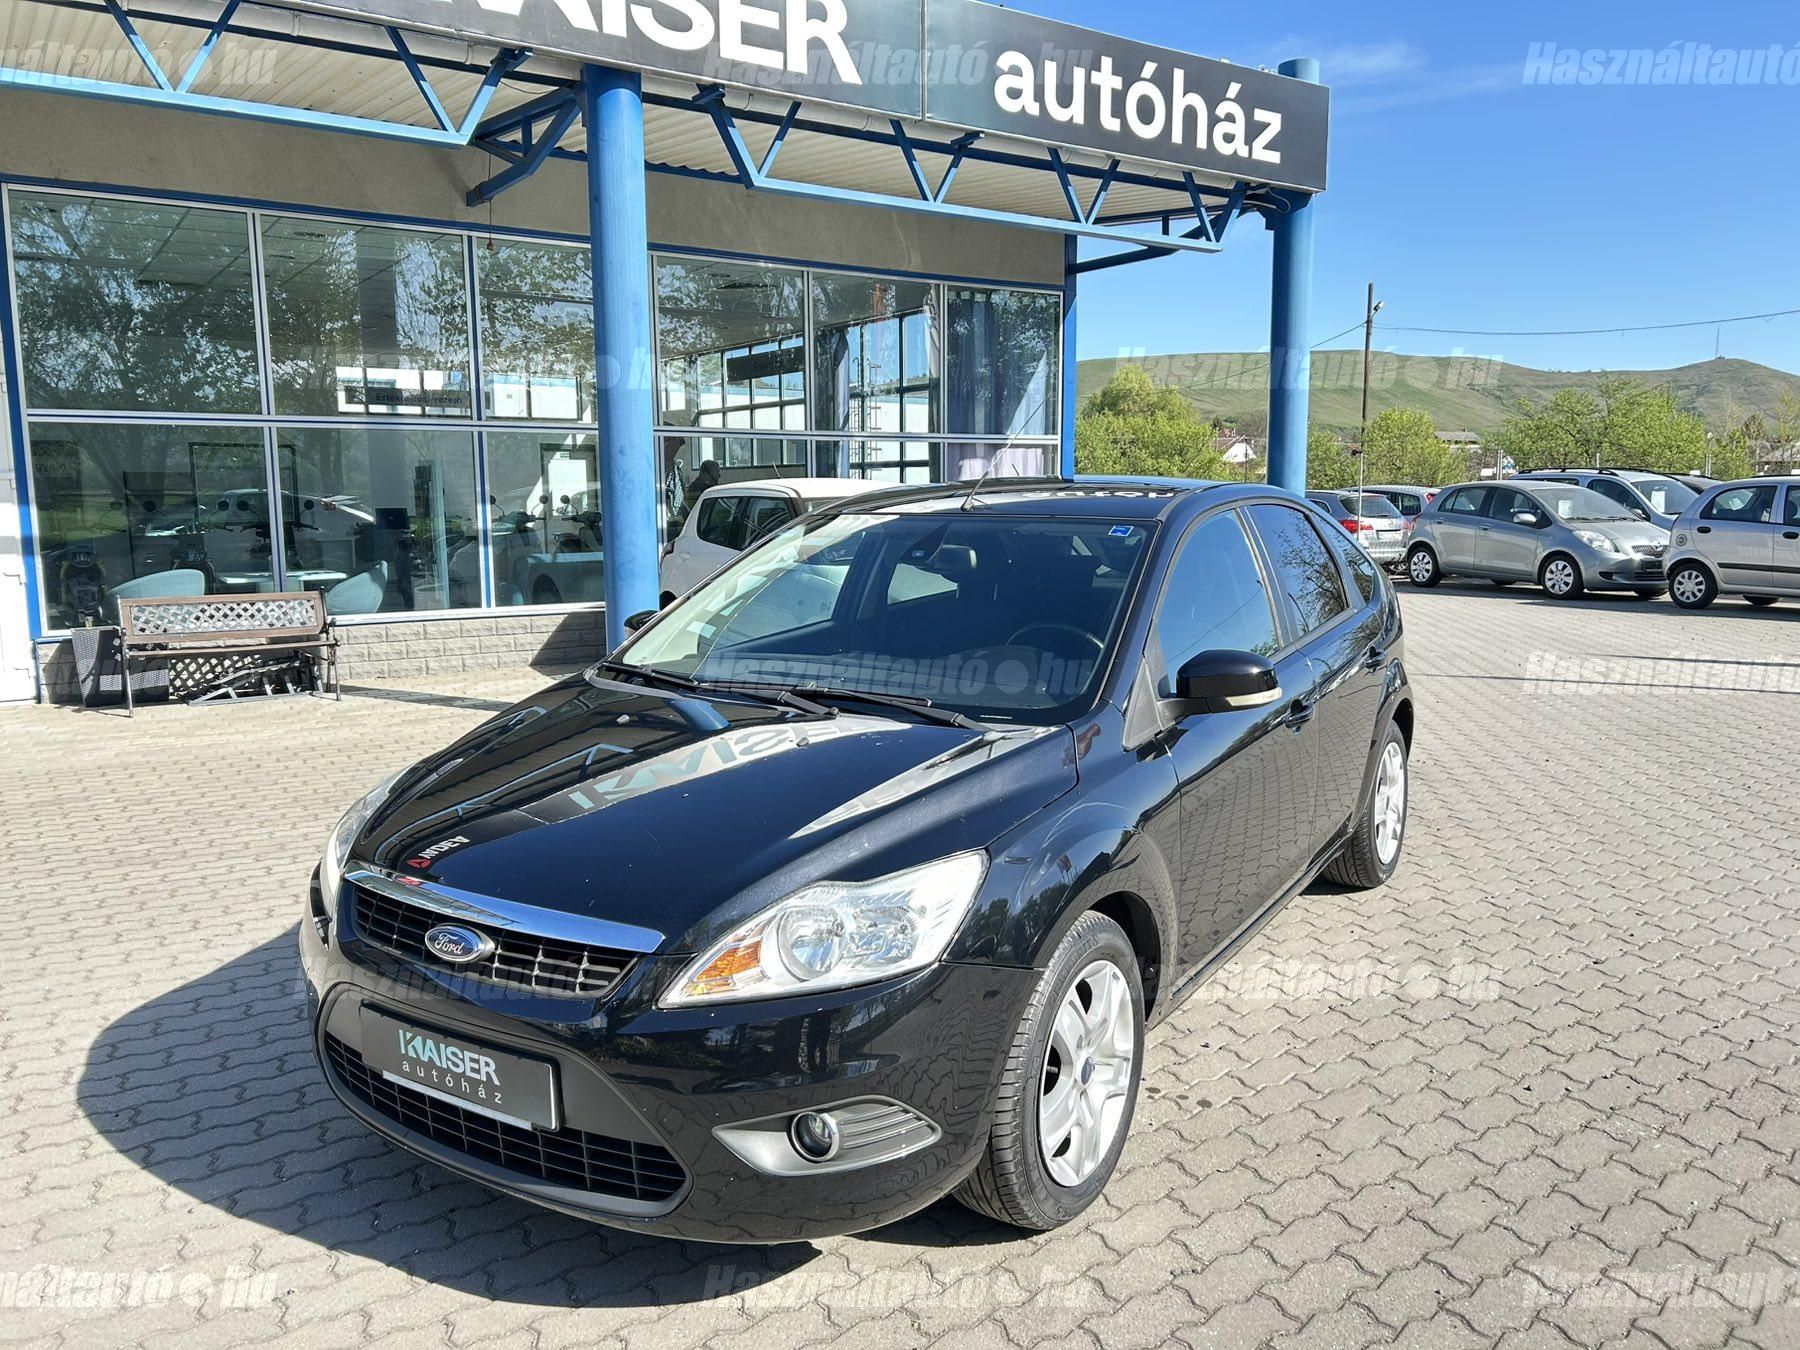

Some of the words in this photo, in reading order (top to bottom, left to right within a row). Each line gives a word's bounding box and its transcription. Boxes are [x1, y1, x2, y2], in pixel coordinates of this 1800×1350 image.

[994, 50, 1282, 164] autóház
[434, 932, 465, 955] Ford
[399, 1029, 501, 1086] KAISER
[402, 1060, 503, 1105] autóház
